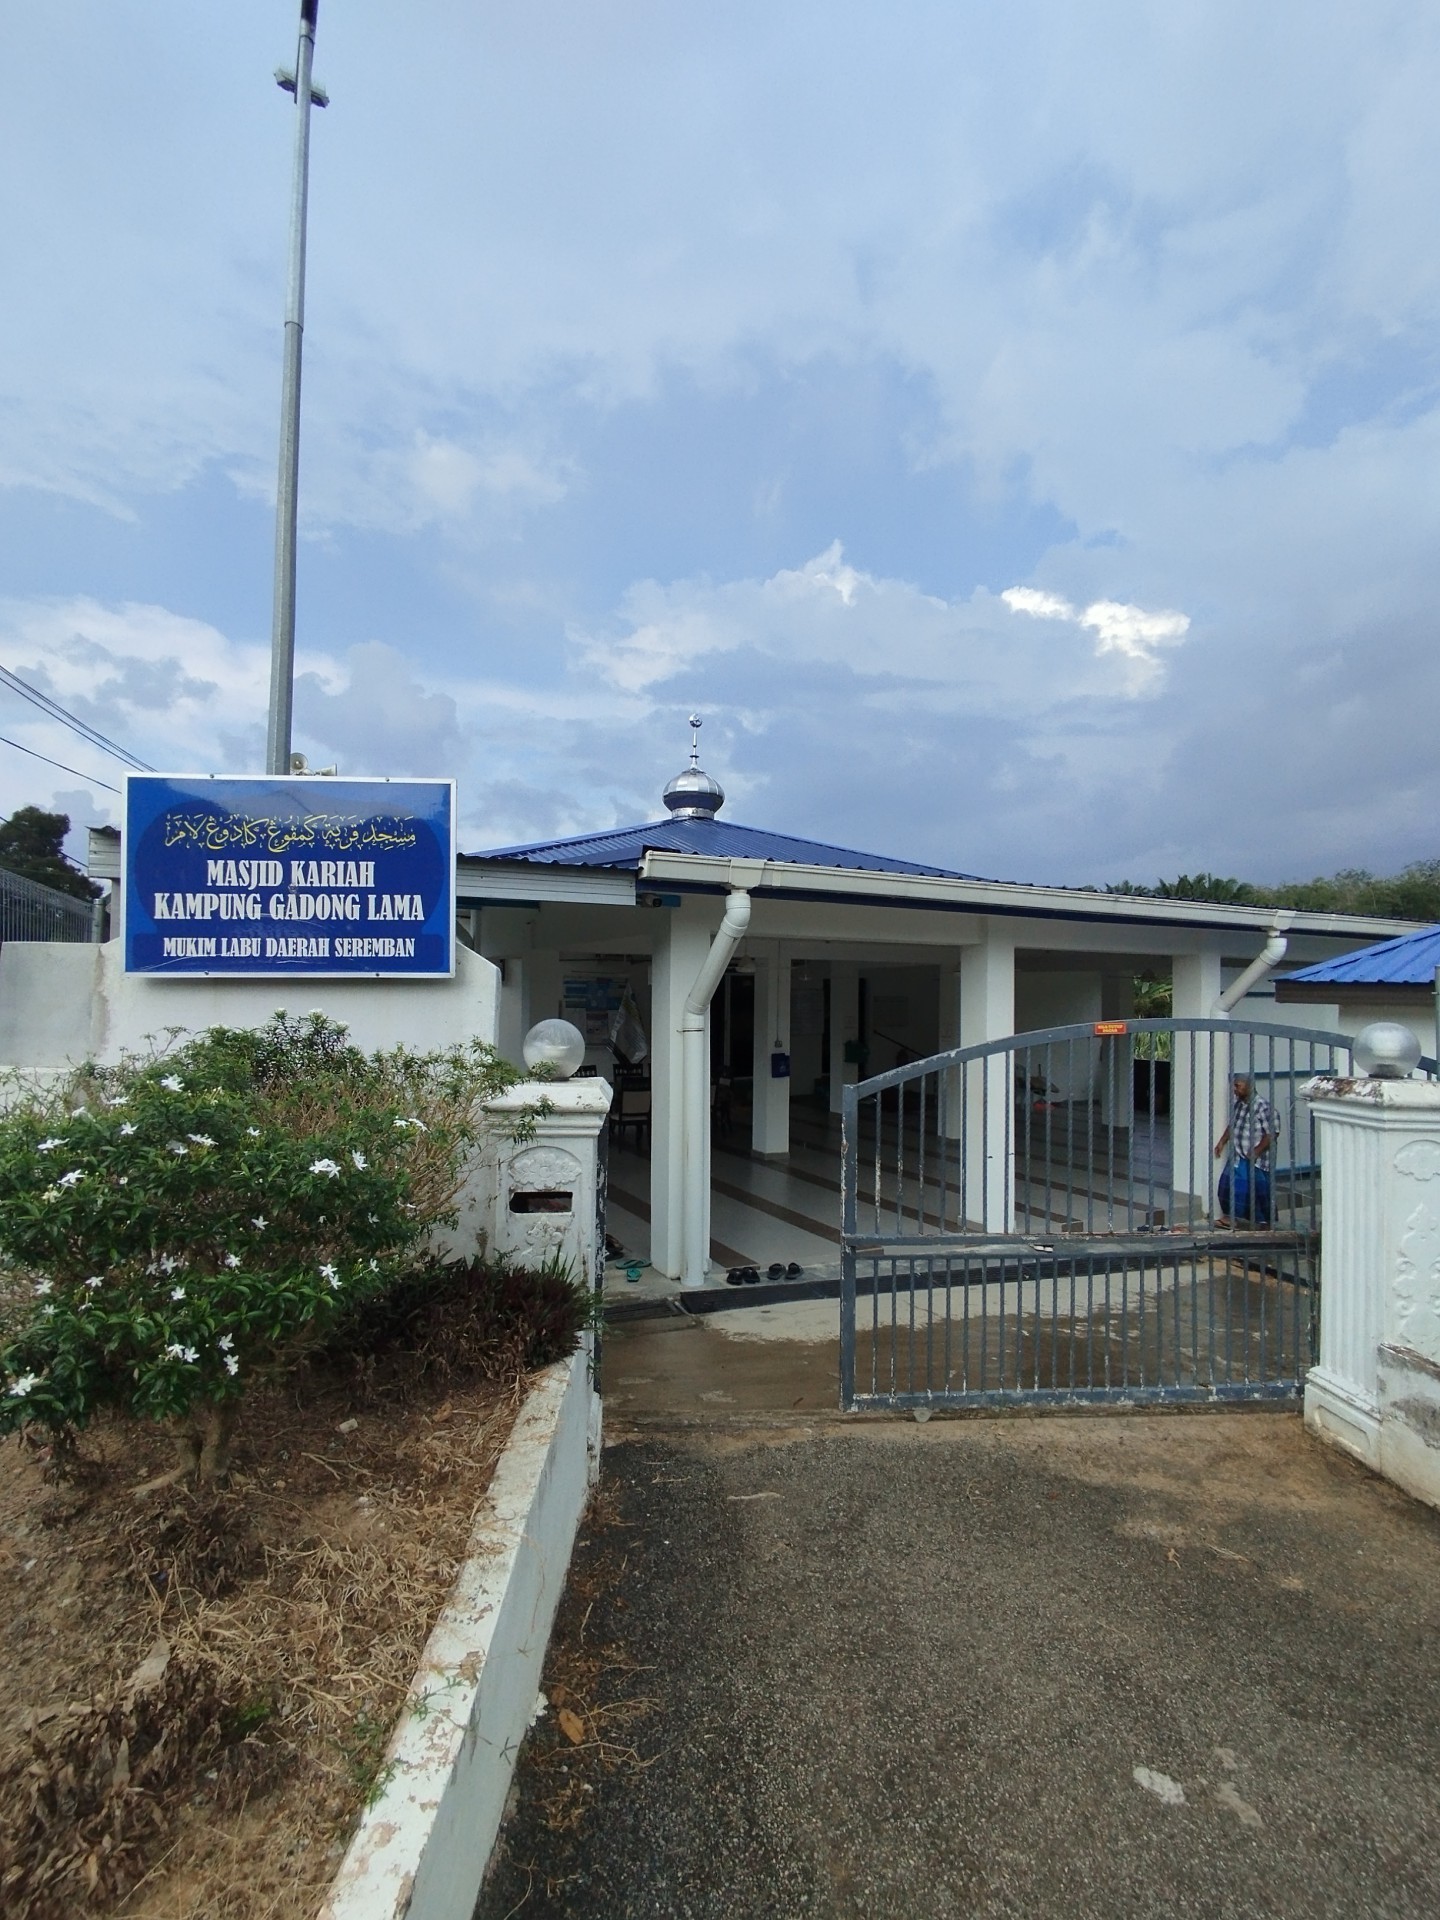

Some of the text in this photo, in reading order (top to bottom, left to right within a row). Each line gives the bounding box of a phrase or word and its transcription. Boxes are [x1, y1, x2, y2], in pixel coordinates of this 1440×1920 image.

[206, 860, 376, 890] MASJID KARIAH
[154, 892, 425, 921] KAMPUNG GADONG LAMA
[163, 937, 415, 957] MUKIM LABU DAERAH SEREMBAN
